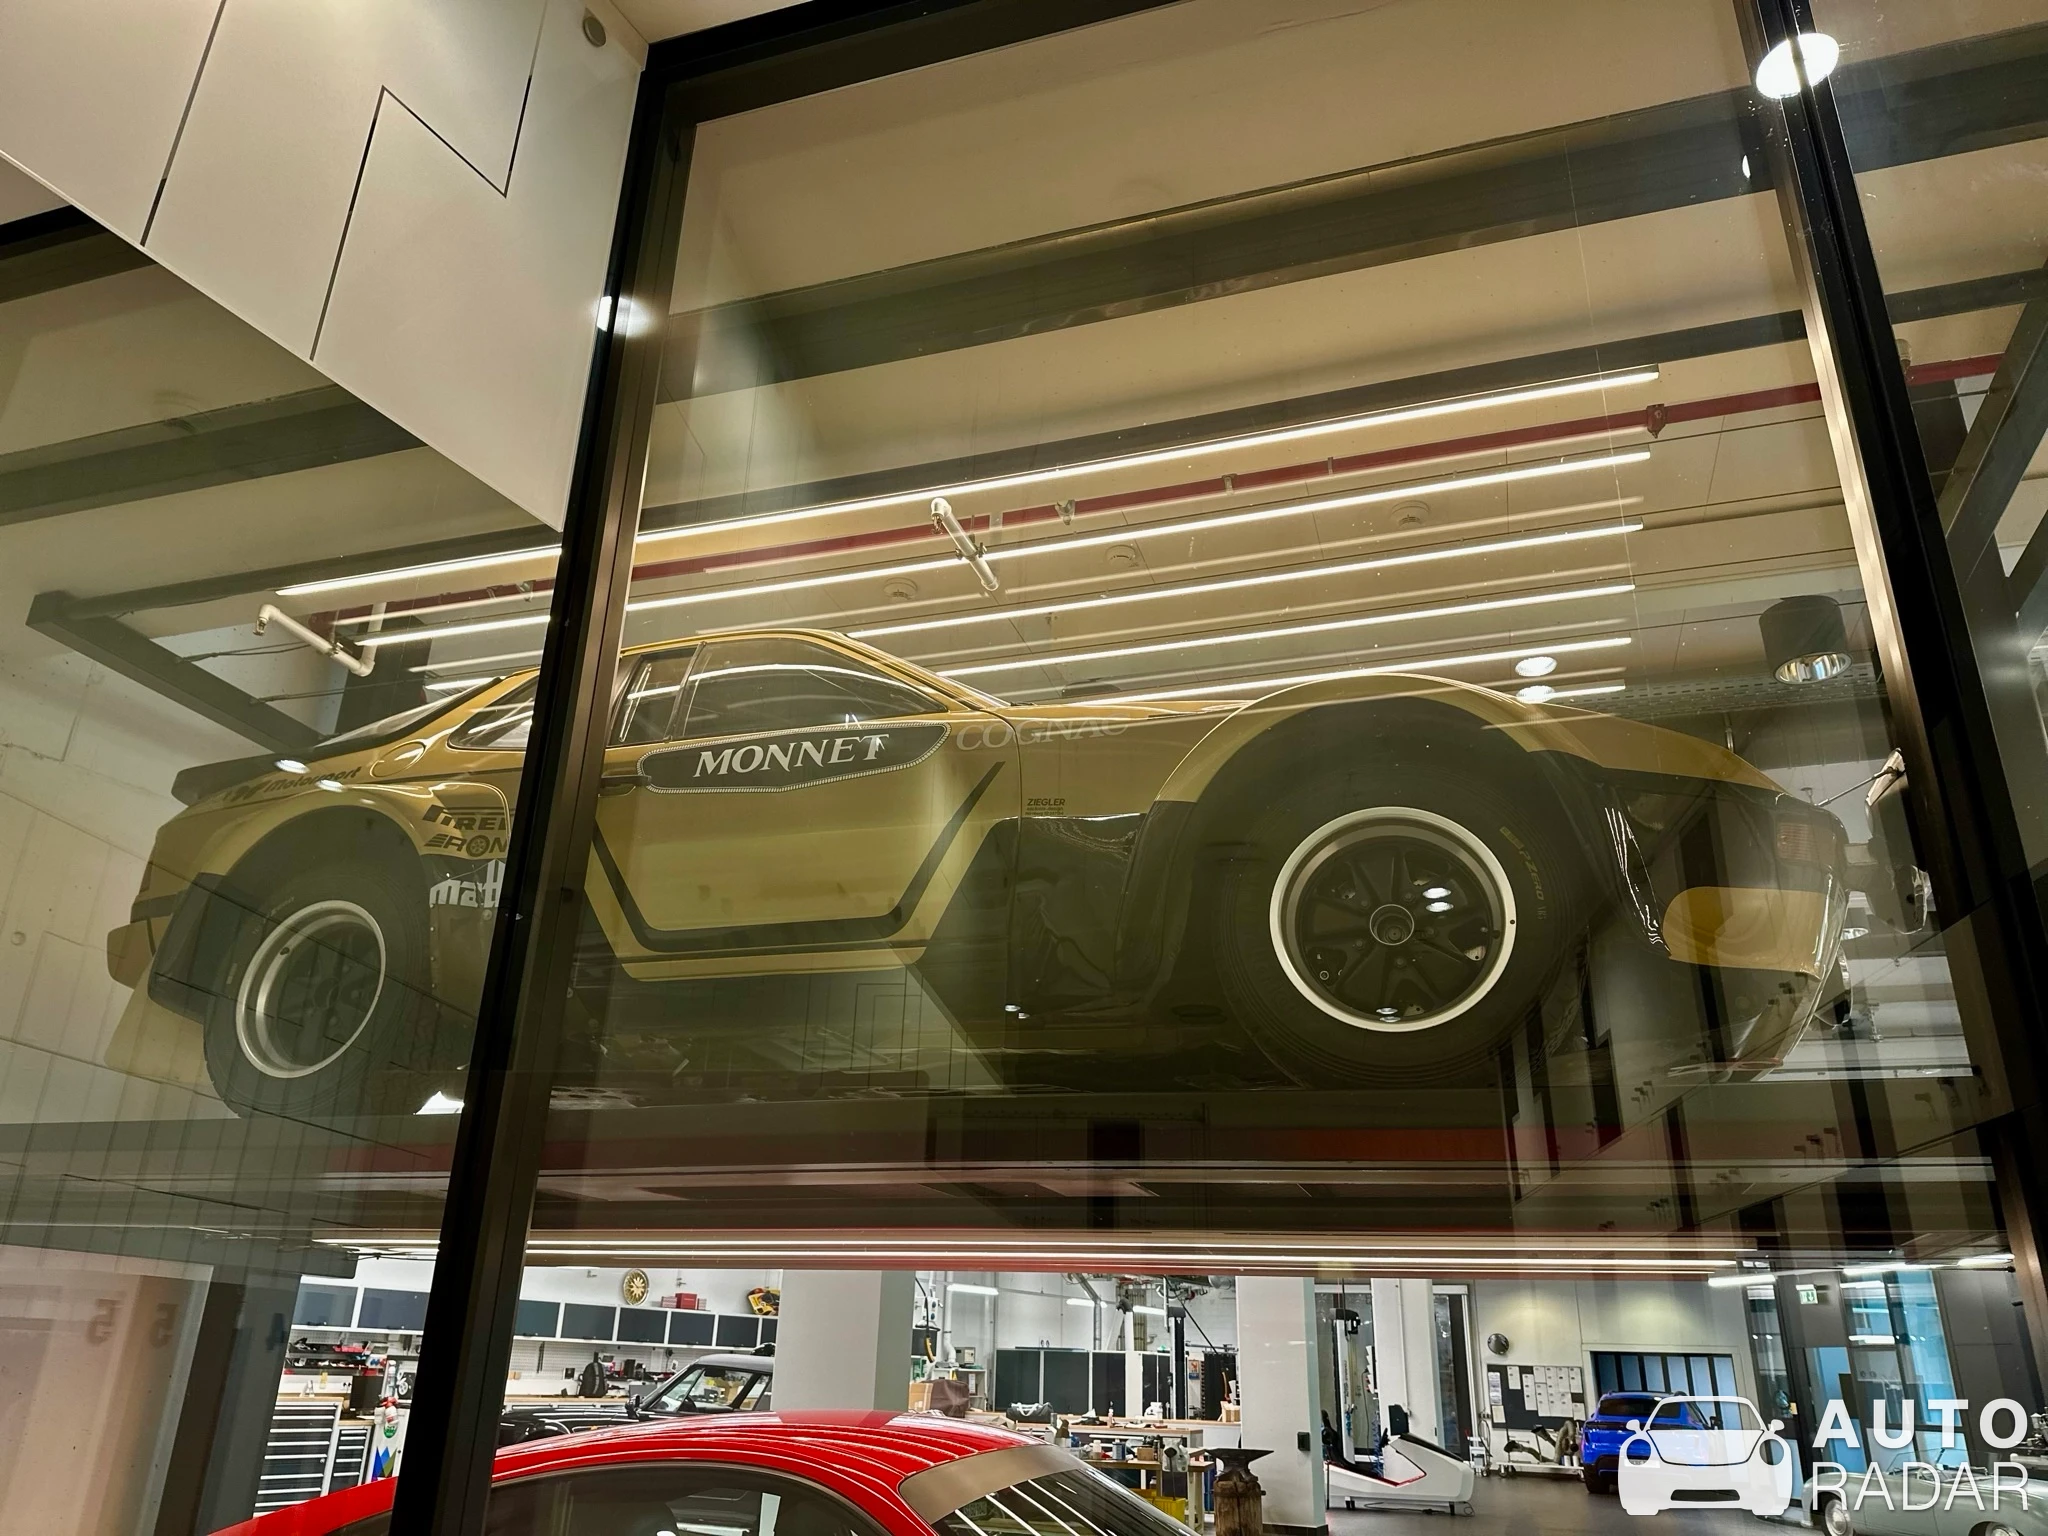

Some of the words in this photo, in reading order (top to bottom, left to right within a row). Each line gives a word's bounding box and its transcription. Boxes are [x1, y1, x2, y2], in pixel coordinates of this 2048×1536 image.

[956, 713, 1130, 750] COGNAC
[692, 732, 890, 778] MONNET
[1026, 798, 1066, 806] ZIEGLER
